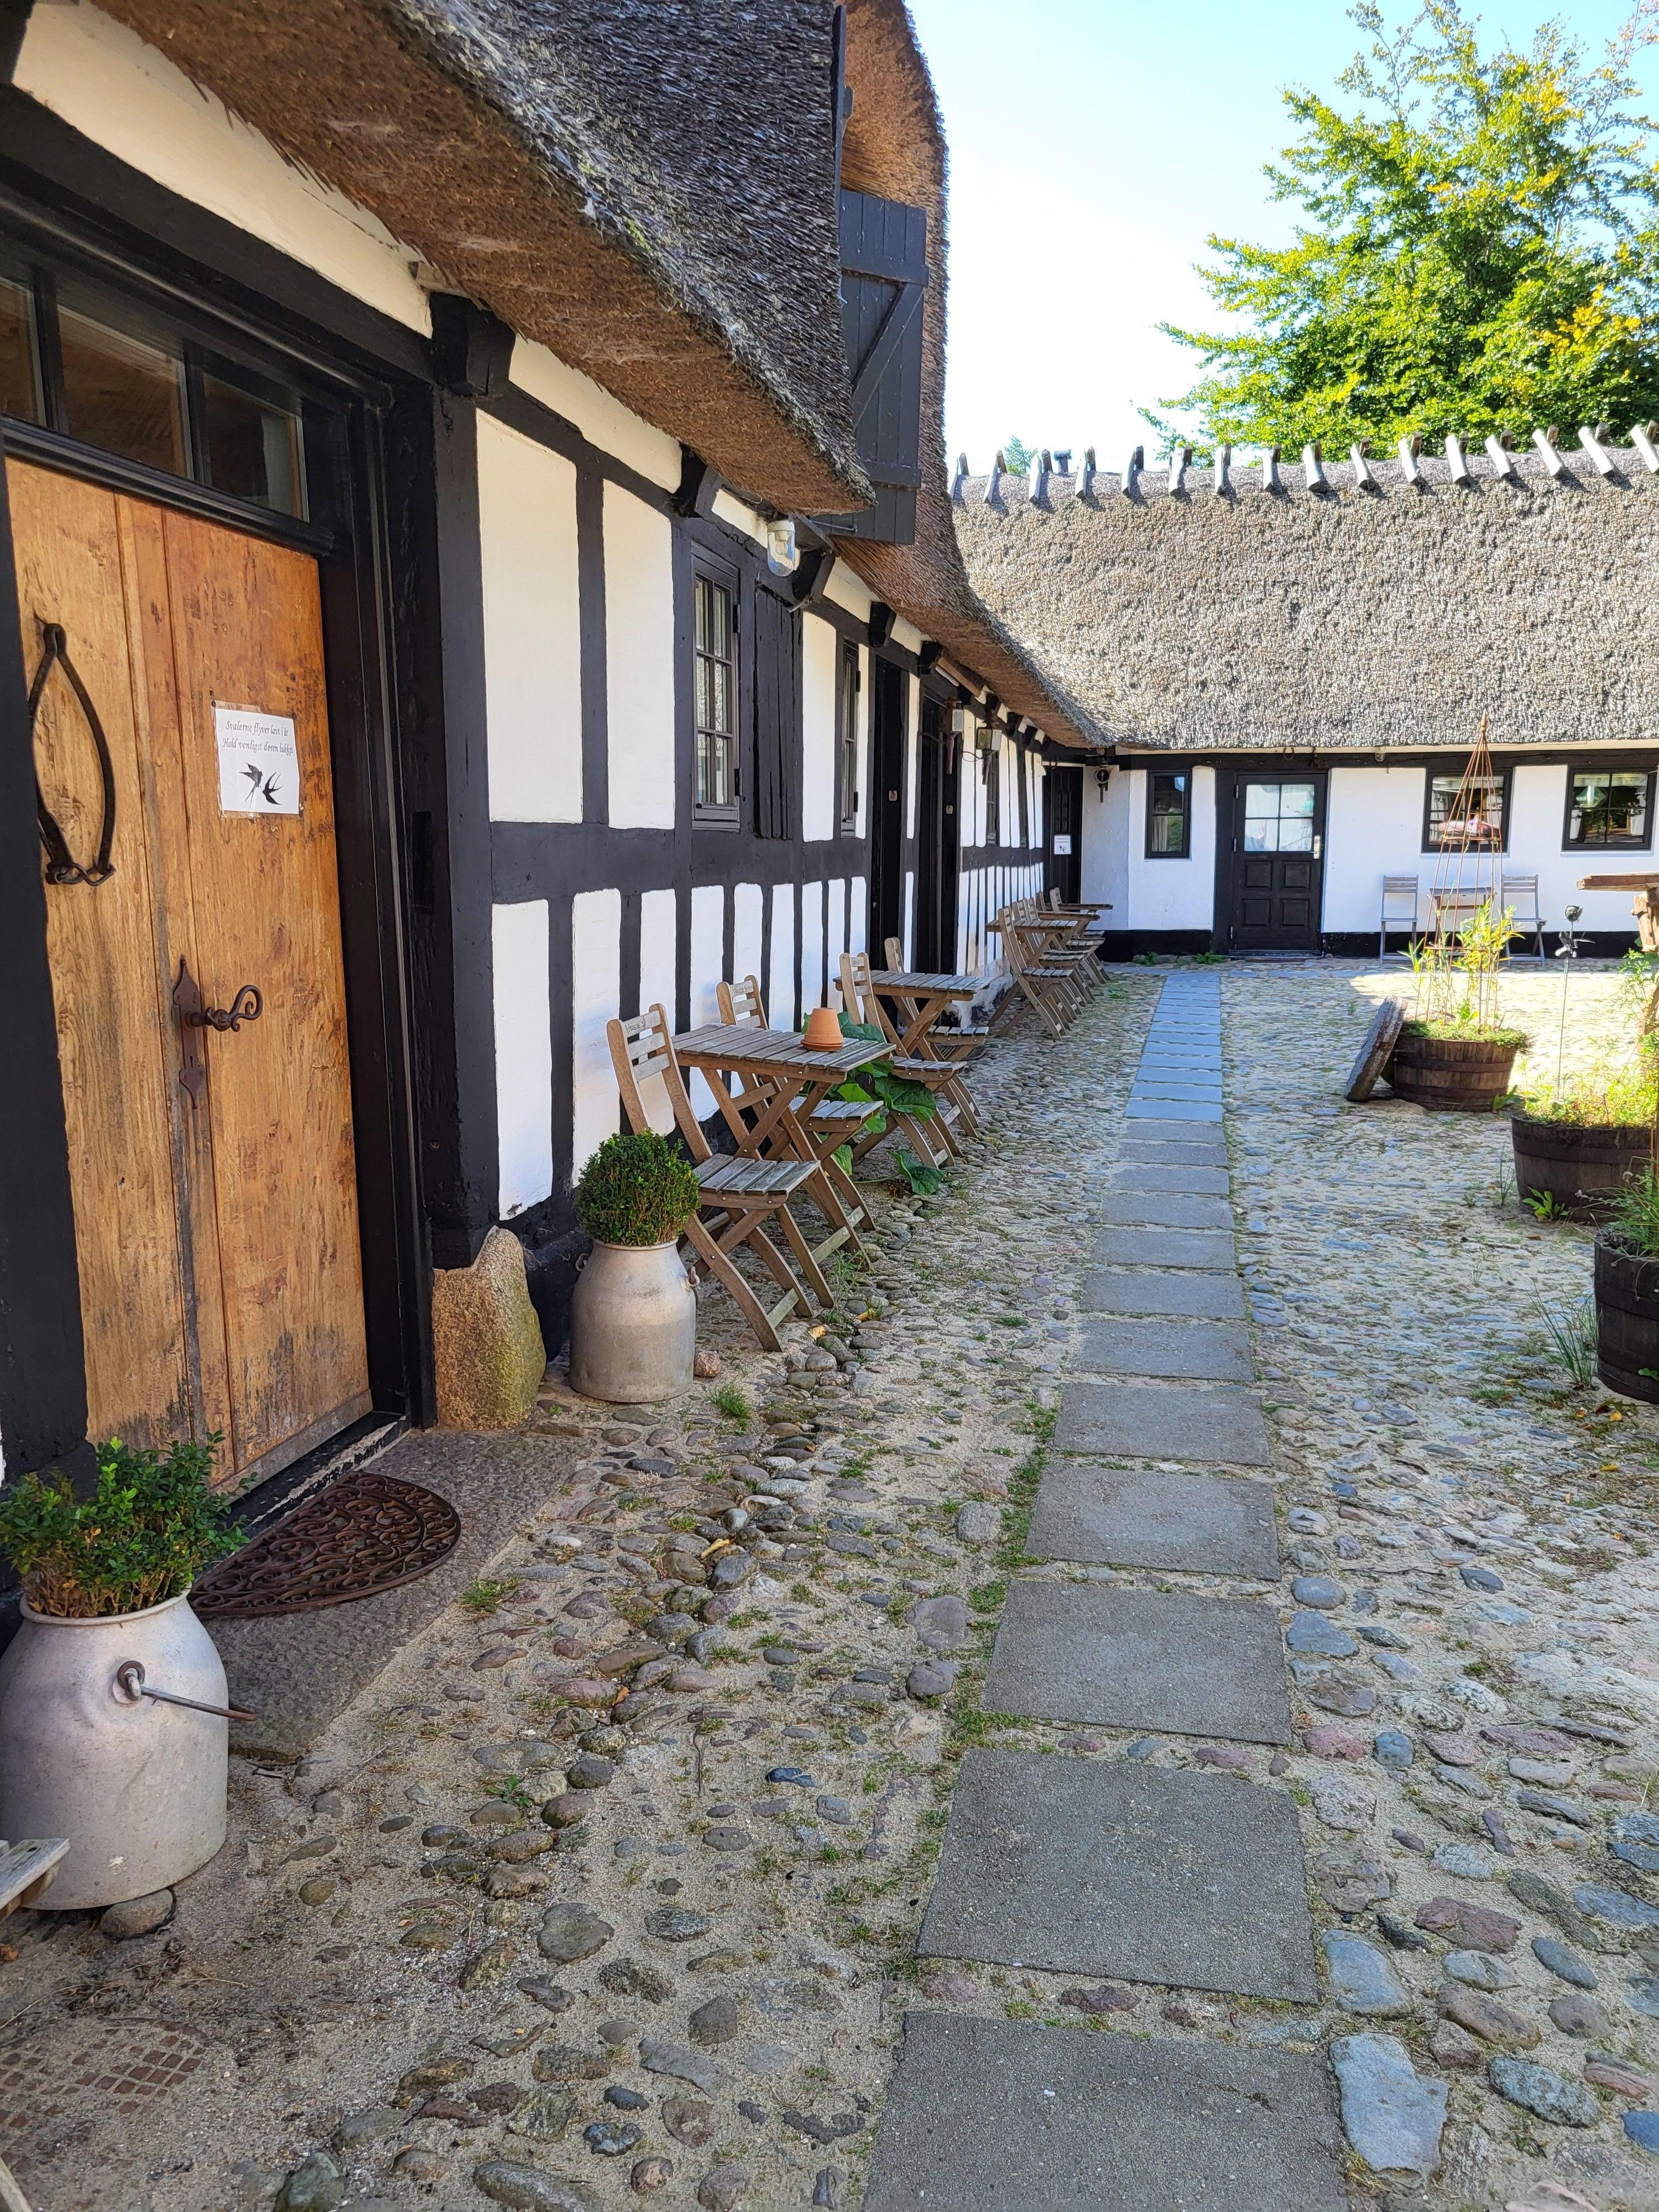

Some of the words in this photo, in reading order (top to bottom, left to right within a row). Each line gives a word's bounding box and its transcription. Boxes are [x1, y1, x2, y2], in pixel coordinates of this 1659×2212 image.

[226, 721, 252, 732] Svalerne
[252, 722, 270, 736] flyver
[270, 724, 280, 736] lavt
[223, 738, 238, 749] Hold
[238, 739, 262, 754] venligst
[279, 743, 294, 756] lukket
